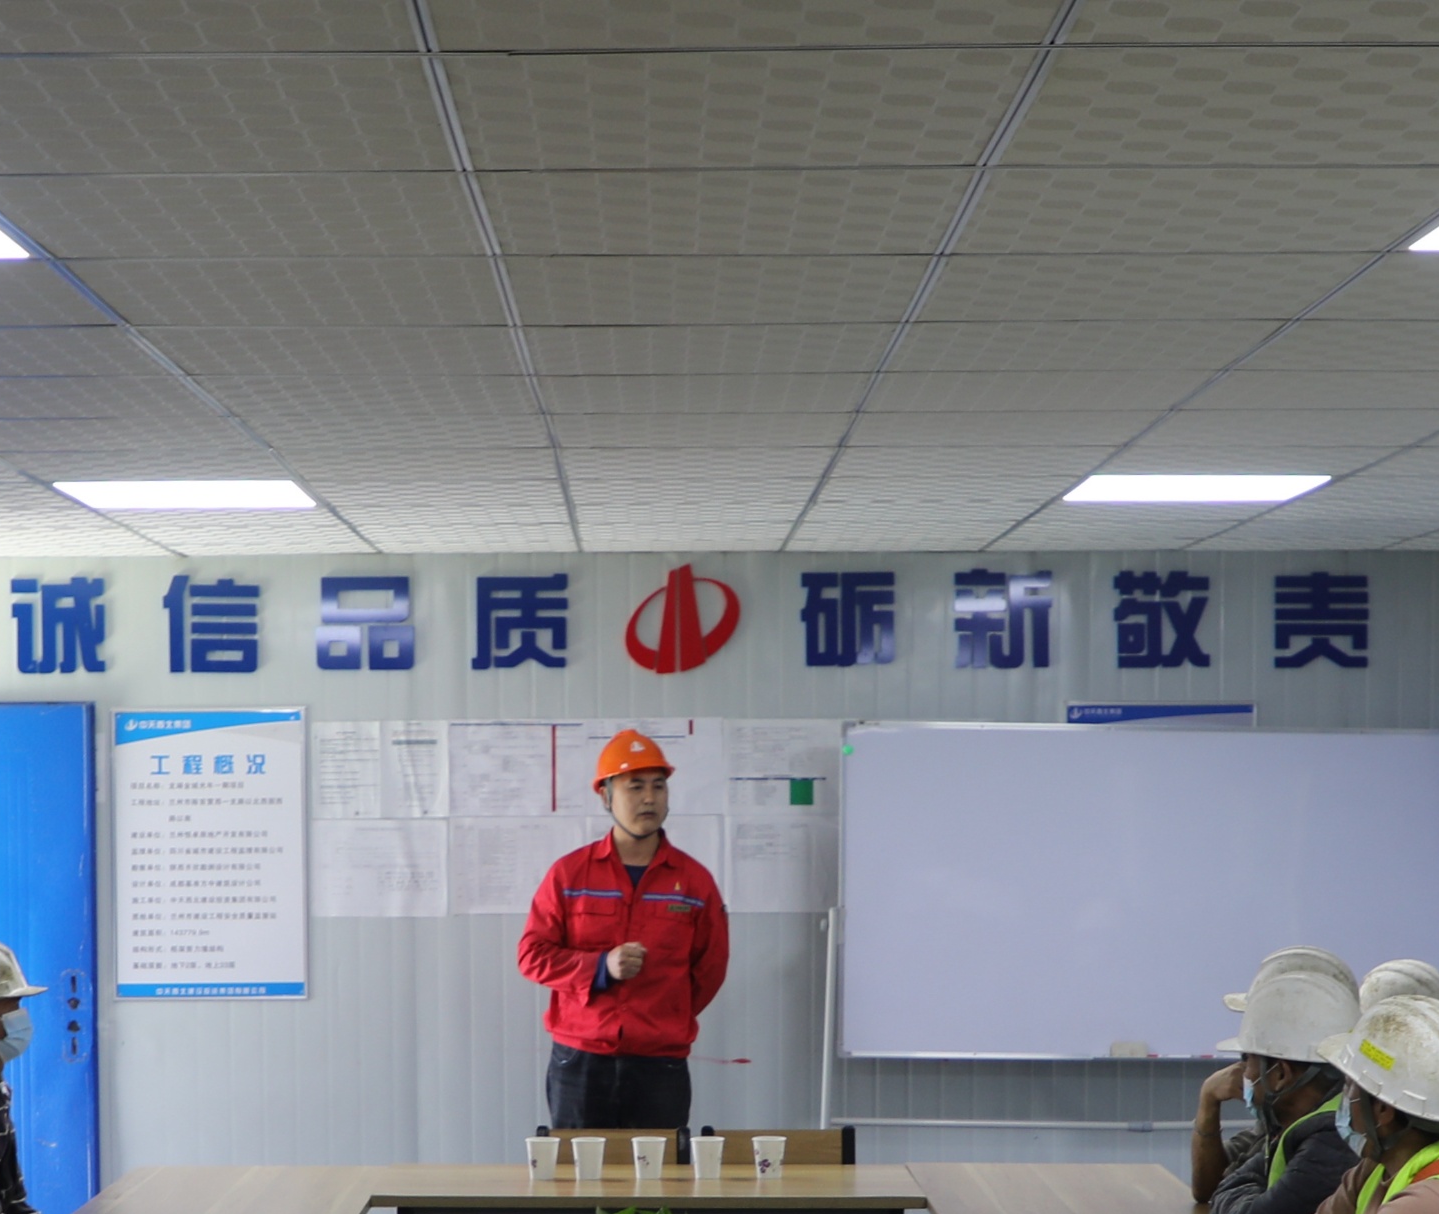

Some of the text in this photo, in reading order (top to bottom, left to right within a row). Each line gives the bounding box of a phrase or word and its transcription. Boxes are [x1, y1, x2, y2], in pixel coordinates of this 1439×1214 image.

[11, 568, 1369, 674] 诚信品质 砺新敬责
[150, 754, 267, 776] 工程概况
